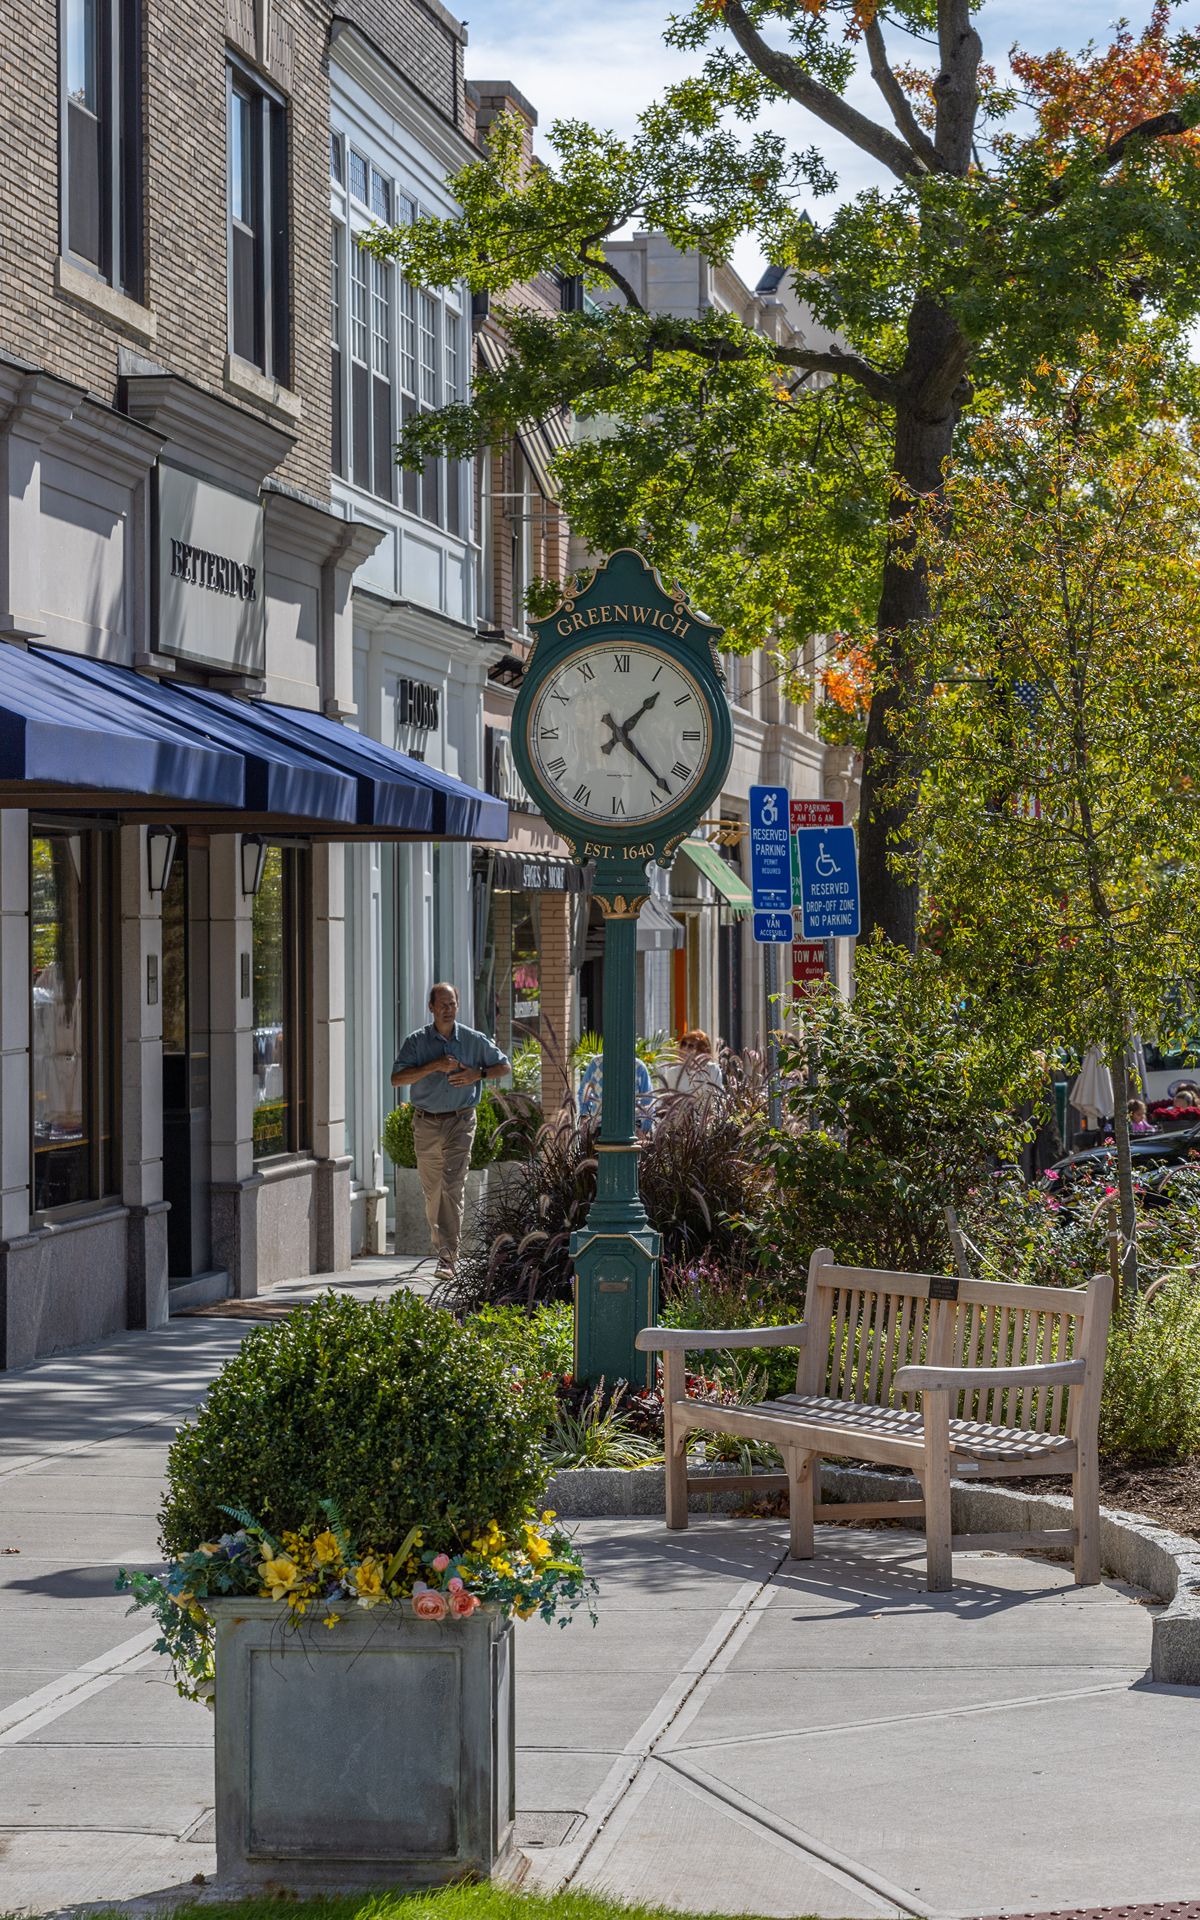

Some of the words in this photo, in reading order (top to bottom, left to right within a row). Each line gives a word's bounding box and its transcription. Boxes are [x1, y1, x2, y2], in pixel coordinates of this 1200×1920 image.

[170, 537, 256, 601] BETTERIDGE
[557, 605, 691, 639] GREENWICH
[614, 655, 630, 673] XII
[576, 663, 595, 683] XI
[551, 690, 570, 706] X
[541, 727, 559, 740] IX
[683, 731, 700, 741] III
[573, 784, 592, 807] VII
[612, 797, 626, 815] VI
[794, 803, 803, 812] NO
[804, 803, 830, 813] PARKING
[797, 814, 807, 822] AM
[808, 814, 816, 822] TO
[818, 814, 823, 822] 6
[825, 814, 834, 822] AM
[753, 828, 787, 841] RESERVED
[584, 842, 614, 859] EST.
[622, 843, 655, 860] 1640
[755, 844, 786, 856] PARKING
[811, 882, 849, 896] RESERVED
[806, 900, 837, 913] DROP-OFF
[840, 899, 855, 911] ZONE
[766, 919, 780, 928] VAN
[810, 915, 820, 927] NO
[822, 913, 852, 926] PARKING
[760, 929, 787, 937] ACCESSIBLE
[794, 950, 809, 963] TOW
[805, 967, 823, 976] during
